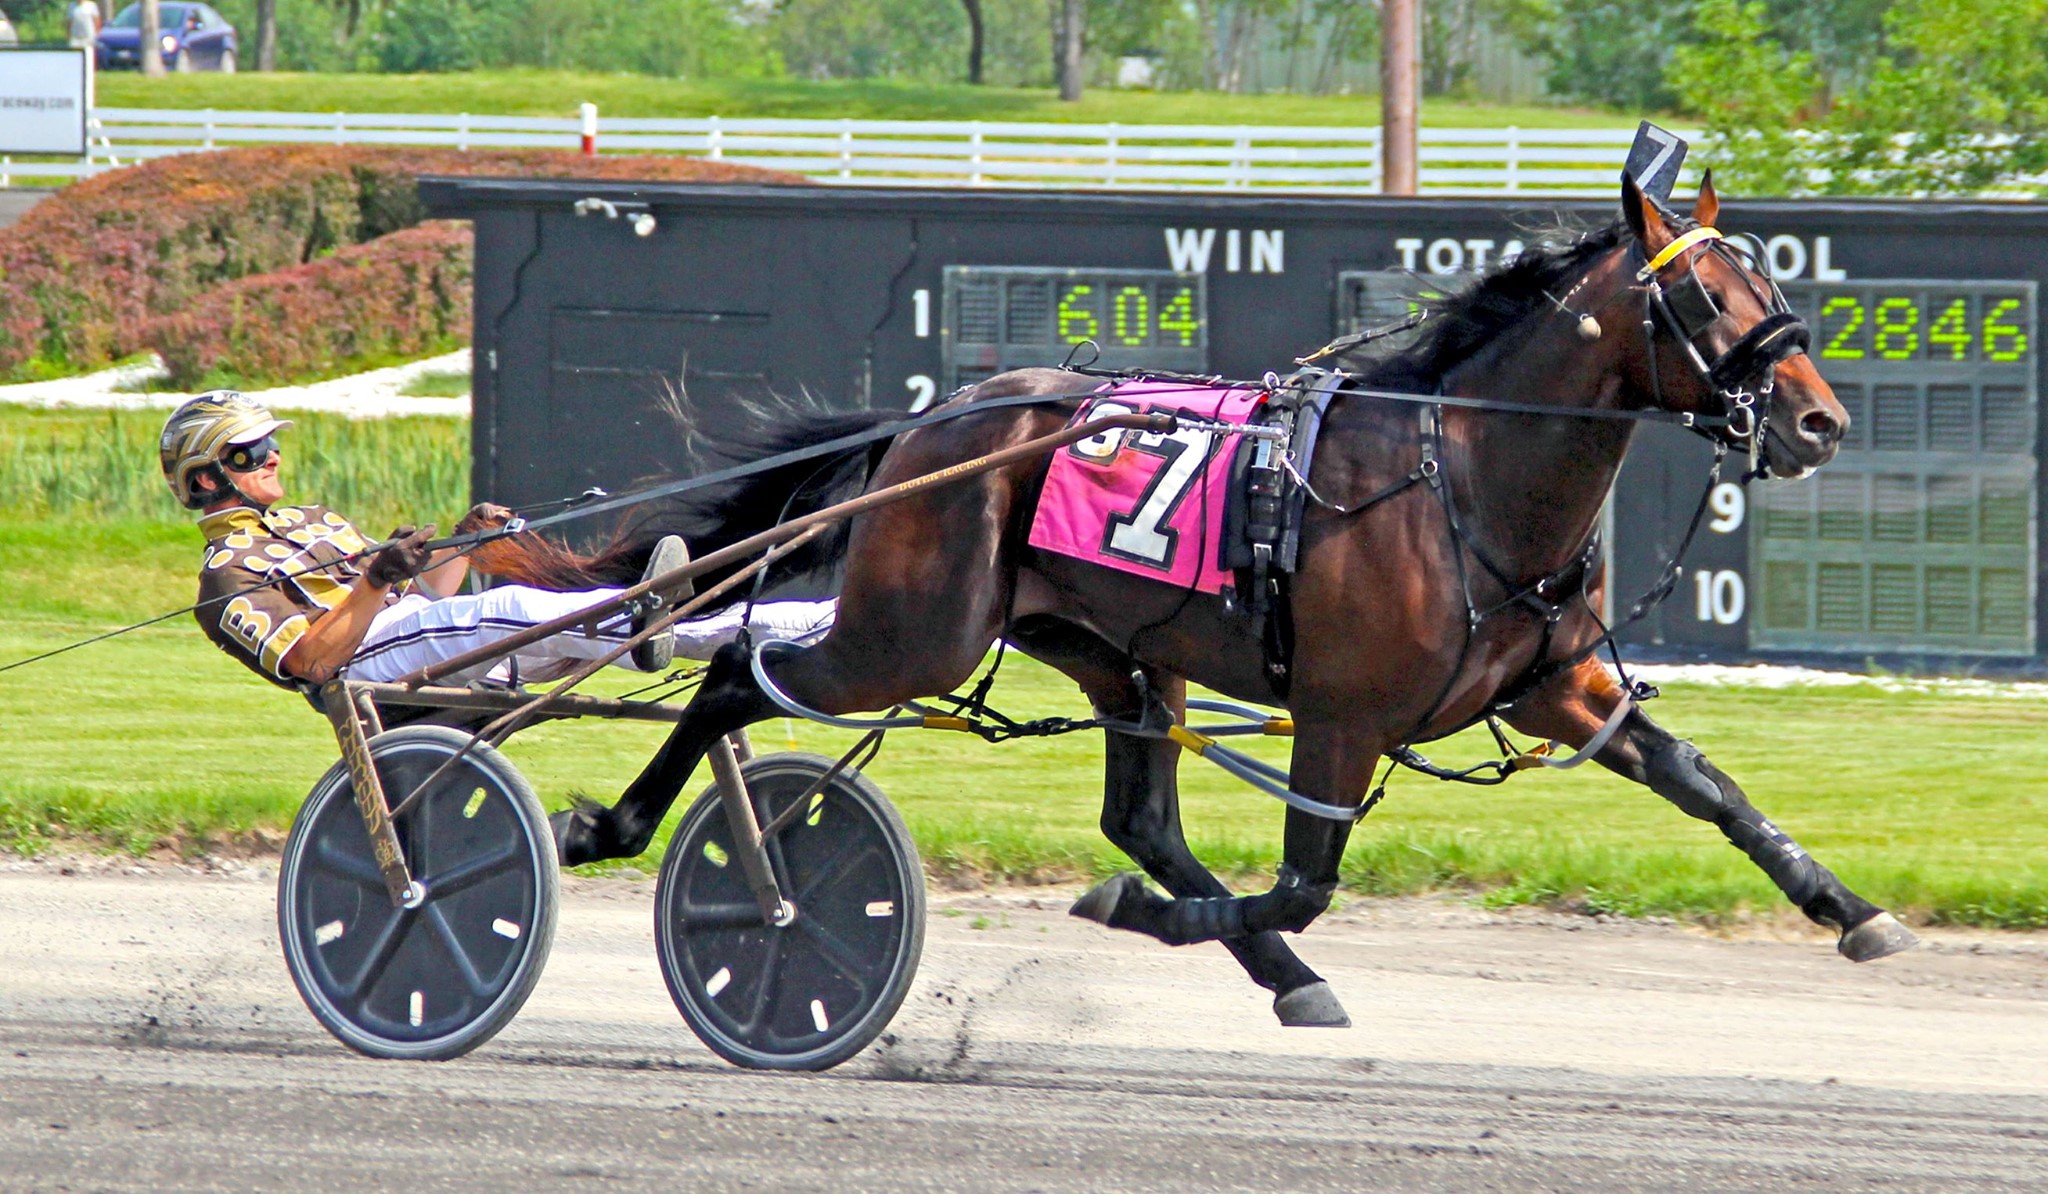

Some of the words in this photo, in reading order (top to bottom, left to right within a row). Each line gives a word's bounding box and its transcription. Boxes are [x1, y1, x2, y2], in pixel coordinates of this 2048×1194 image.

[1635, 125, 1679, 190] 7
[1163, 227, 1285, 273] WIN
[1395, 237, 1553, 276] TOTA
[912, 288, 931, 337] 1
[1057, 284, 1199, 347] 604
[1820, 296, 2029, 362] 2846
[905, 375, 936, 413] 2
[1709, 482, 1746, 534] 9
[1695, 569, 1746, 625] 10
[219, 596, 272, 656] B
